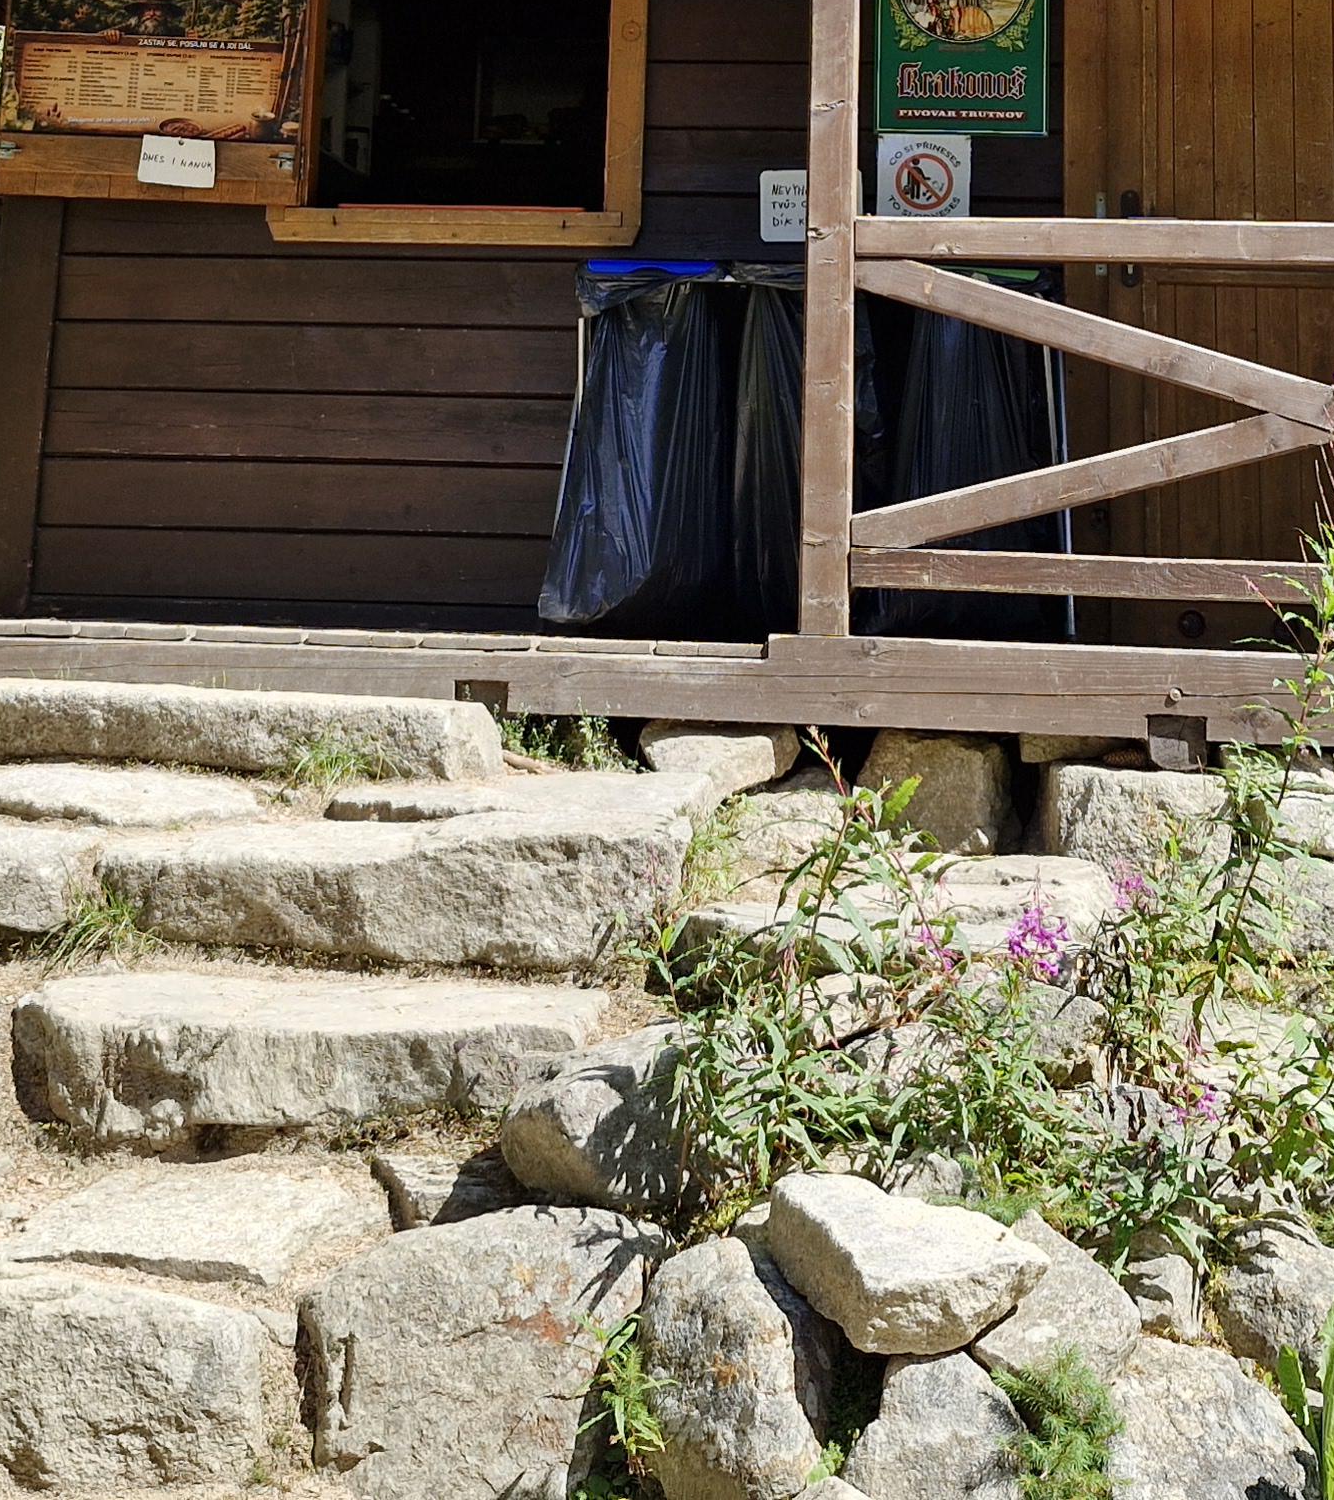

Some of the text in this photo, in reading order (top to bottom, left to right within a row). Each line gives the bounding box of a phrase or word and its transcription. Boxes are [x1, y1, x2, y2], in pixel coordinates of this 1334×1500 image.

[138, 38, 166, 47] ZASTAV
[208, 41, 219, 49] SE
[897, 61, 1028, 100] Krakonoš
[898, 109, 1025, 119] PIVOVAR TRUTNOV
[142, 151, 165, 164] DNES
[889, 151, 903, 166] CO
[904, 144, 914, 153] SI
[888, 194, 901, 211] TO
